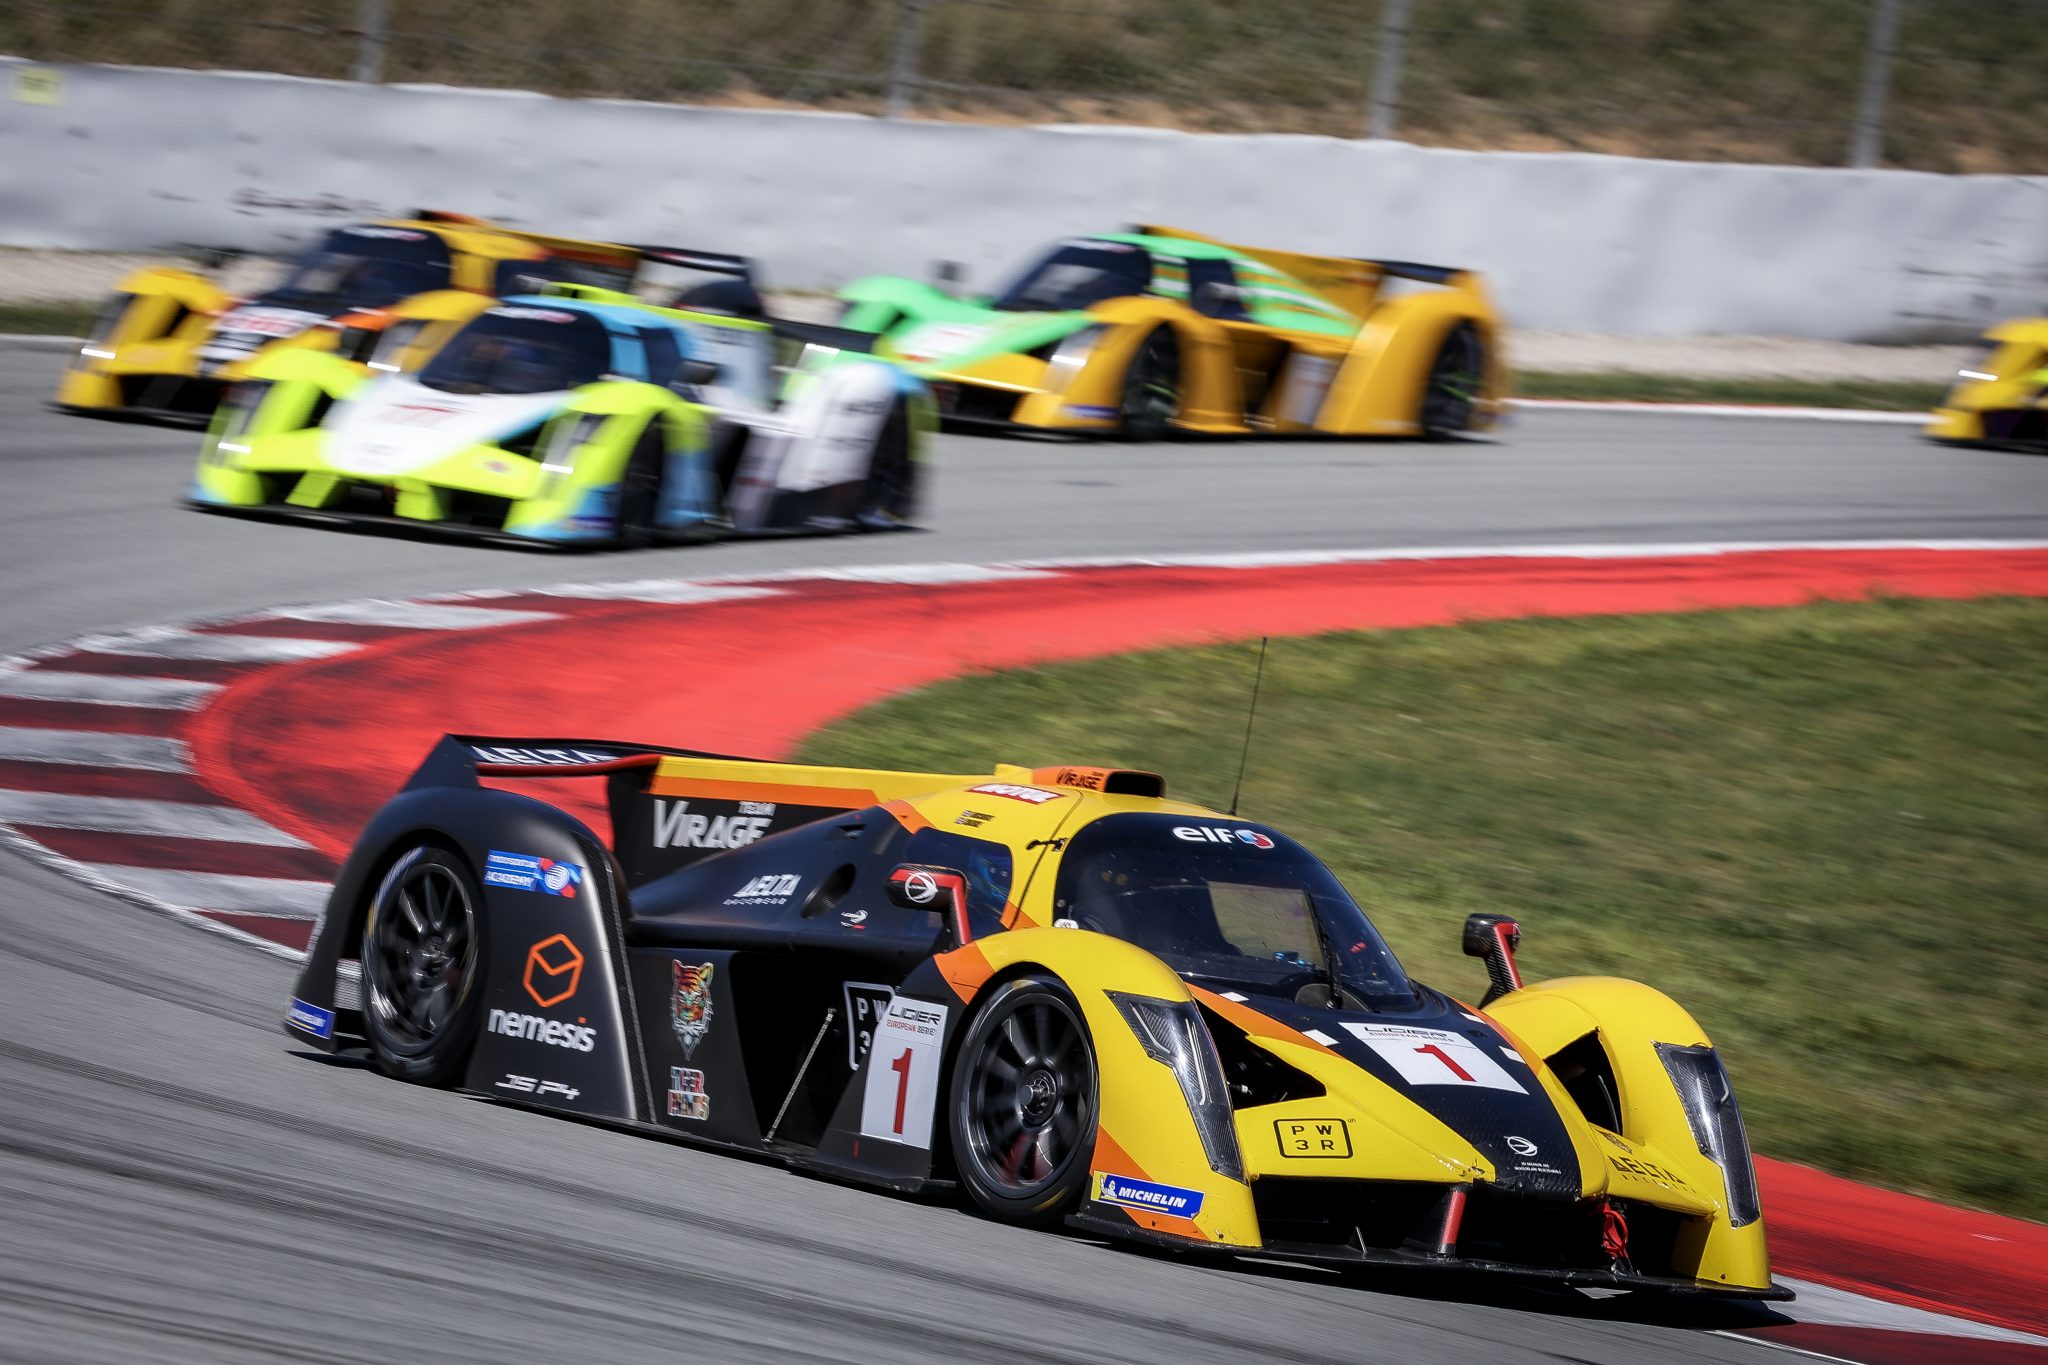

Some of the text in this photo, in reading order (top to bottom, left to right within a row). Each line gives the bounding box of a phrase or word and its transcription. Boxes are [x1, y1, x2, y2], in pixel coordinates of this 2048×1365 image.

[653, 799, 773, 849] VIRAGE
[738, 801, 777, 816] TEAM
[487, 1008, 597, 1052] nemesis
[1413, 1044, 1477, 1083] 1
[891, 1047, 913, 1135] 1
[1118, 1186, 1188, 1208] MICHELIN
